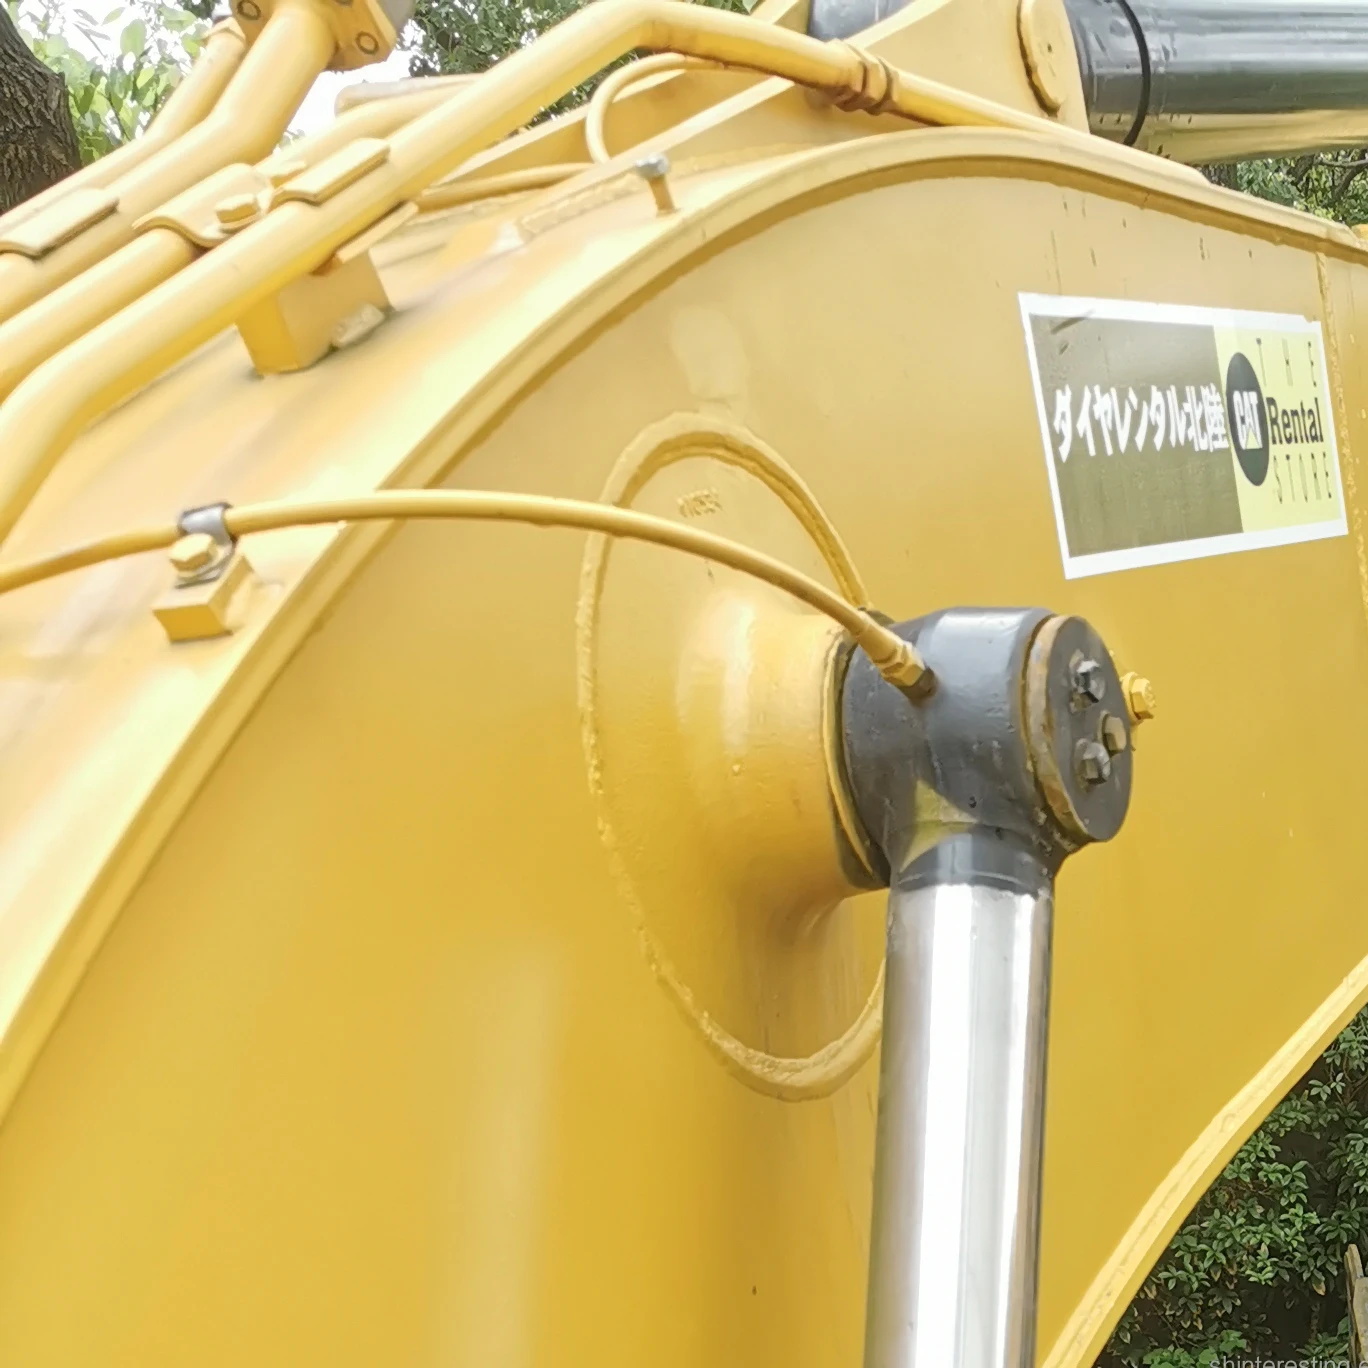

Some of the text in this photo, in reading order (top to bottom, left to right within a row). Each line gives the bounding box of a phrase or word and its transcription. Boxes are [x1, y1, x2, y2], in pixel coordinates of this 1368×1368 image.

[1053, 382, 1230, 463] ダイヤレンタル北陸
[1232, 390, 1323, 451] CAT Rental
